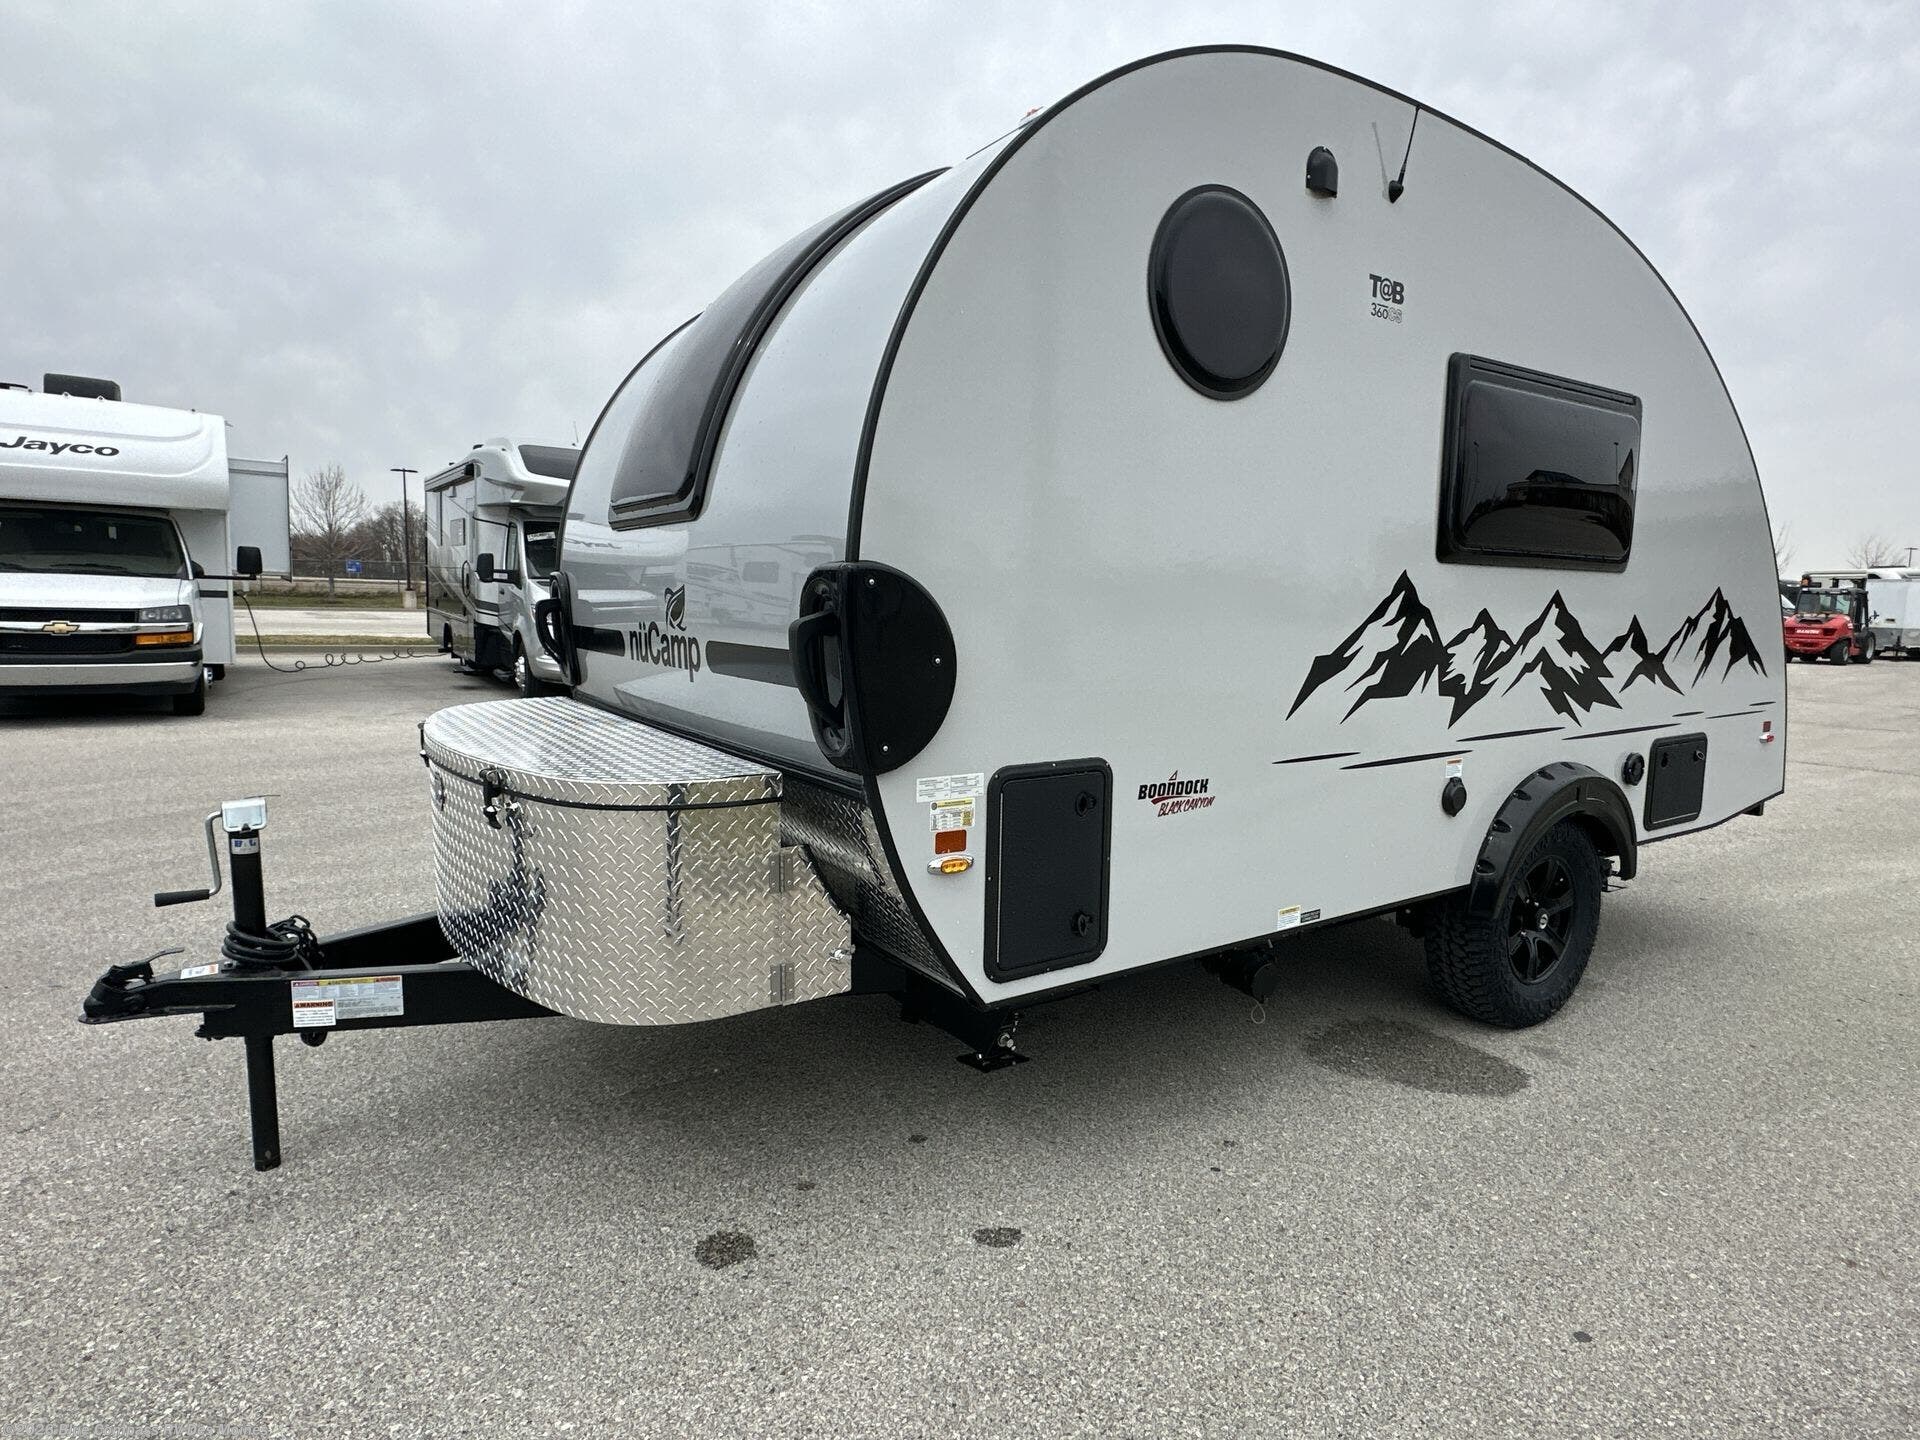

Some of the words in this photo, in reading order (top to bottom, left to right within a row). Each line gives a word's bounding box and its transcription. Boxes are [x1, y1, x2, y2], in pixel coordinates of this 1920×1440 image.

[1369, 273, 1405, 305] T@B
[0, 436, 119, 456] Jayco
[629, 621, 701, 683] nüCamp
[1138, 778, 1209, 800] BOONDOCK
[1157, 800, 1183, 818] BLACK
[1183, 796, 1216, 812] CANYON
